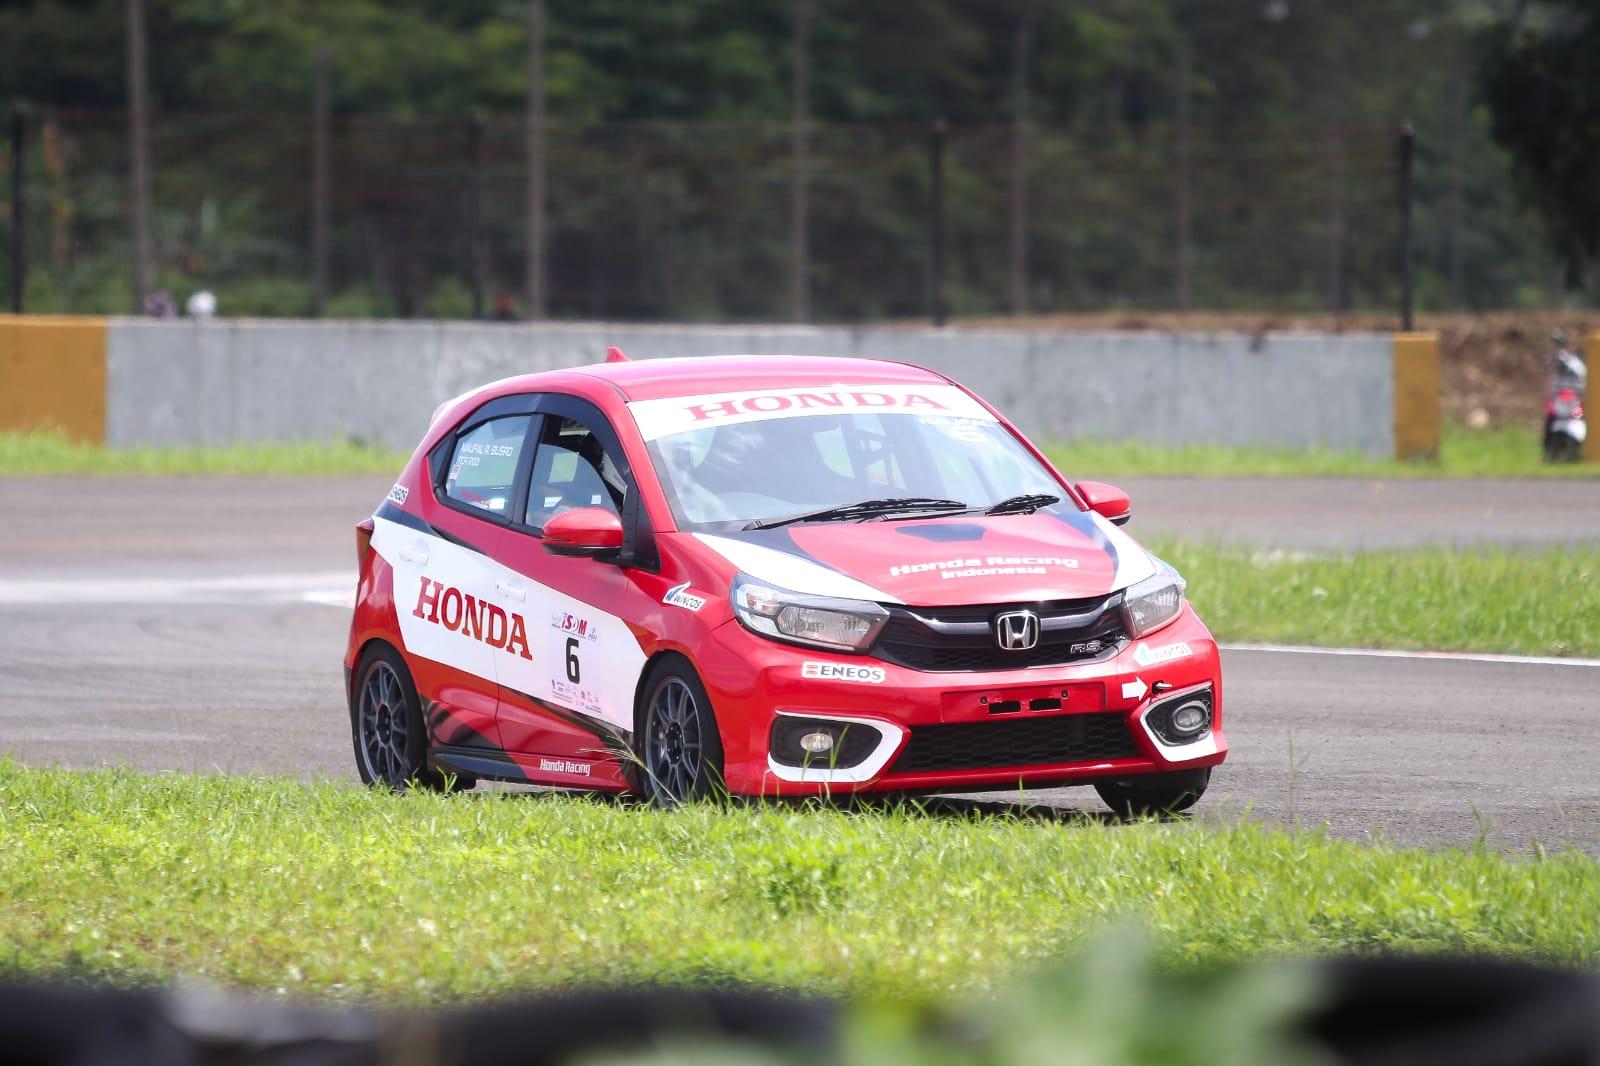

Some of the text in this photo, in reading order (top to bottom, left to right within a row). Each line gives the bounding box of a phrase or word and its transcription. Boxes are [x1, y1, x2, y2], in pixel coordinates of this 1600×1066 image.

[683, 392, 952, 421] HONDA
[890, 557, 1079, 576] Honda Racing
[941, 567, 1047, 579] Indonesia
[412, 576, 533, 661] HONDA
[1070, 640, 1102, 654] RS
[566, 637, 580, 685] 6
[821, 665, 882, 680] ENEOS
[540, 759, 591, 776] Honda Racing
